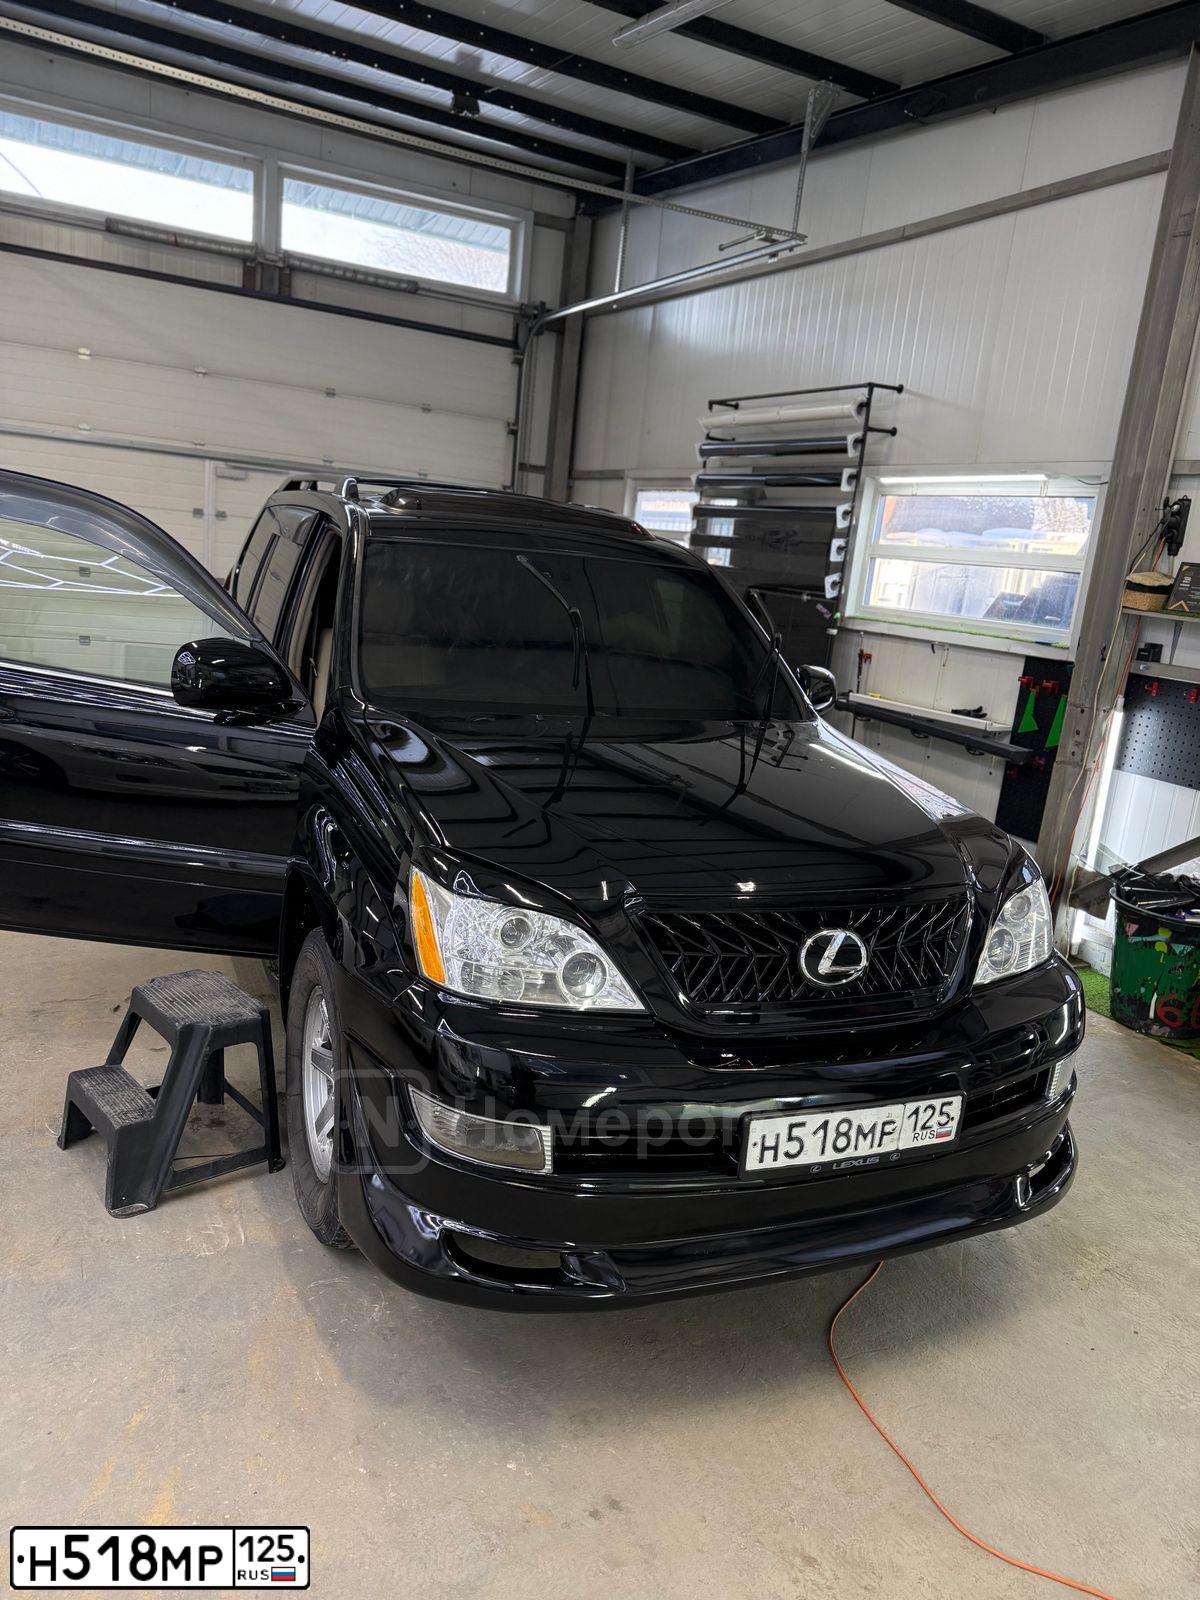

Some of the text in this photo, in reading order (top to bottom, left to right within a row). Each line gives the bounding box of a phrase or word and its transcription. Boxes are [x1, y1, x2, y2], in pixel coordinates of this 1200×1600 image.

[907, 1101, 953, 1132] 125
[912, 1130, 936, 1142] RUS
[832, 1156, 880, 1170] LEXUS
